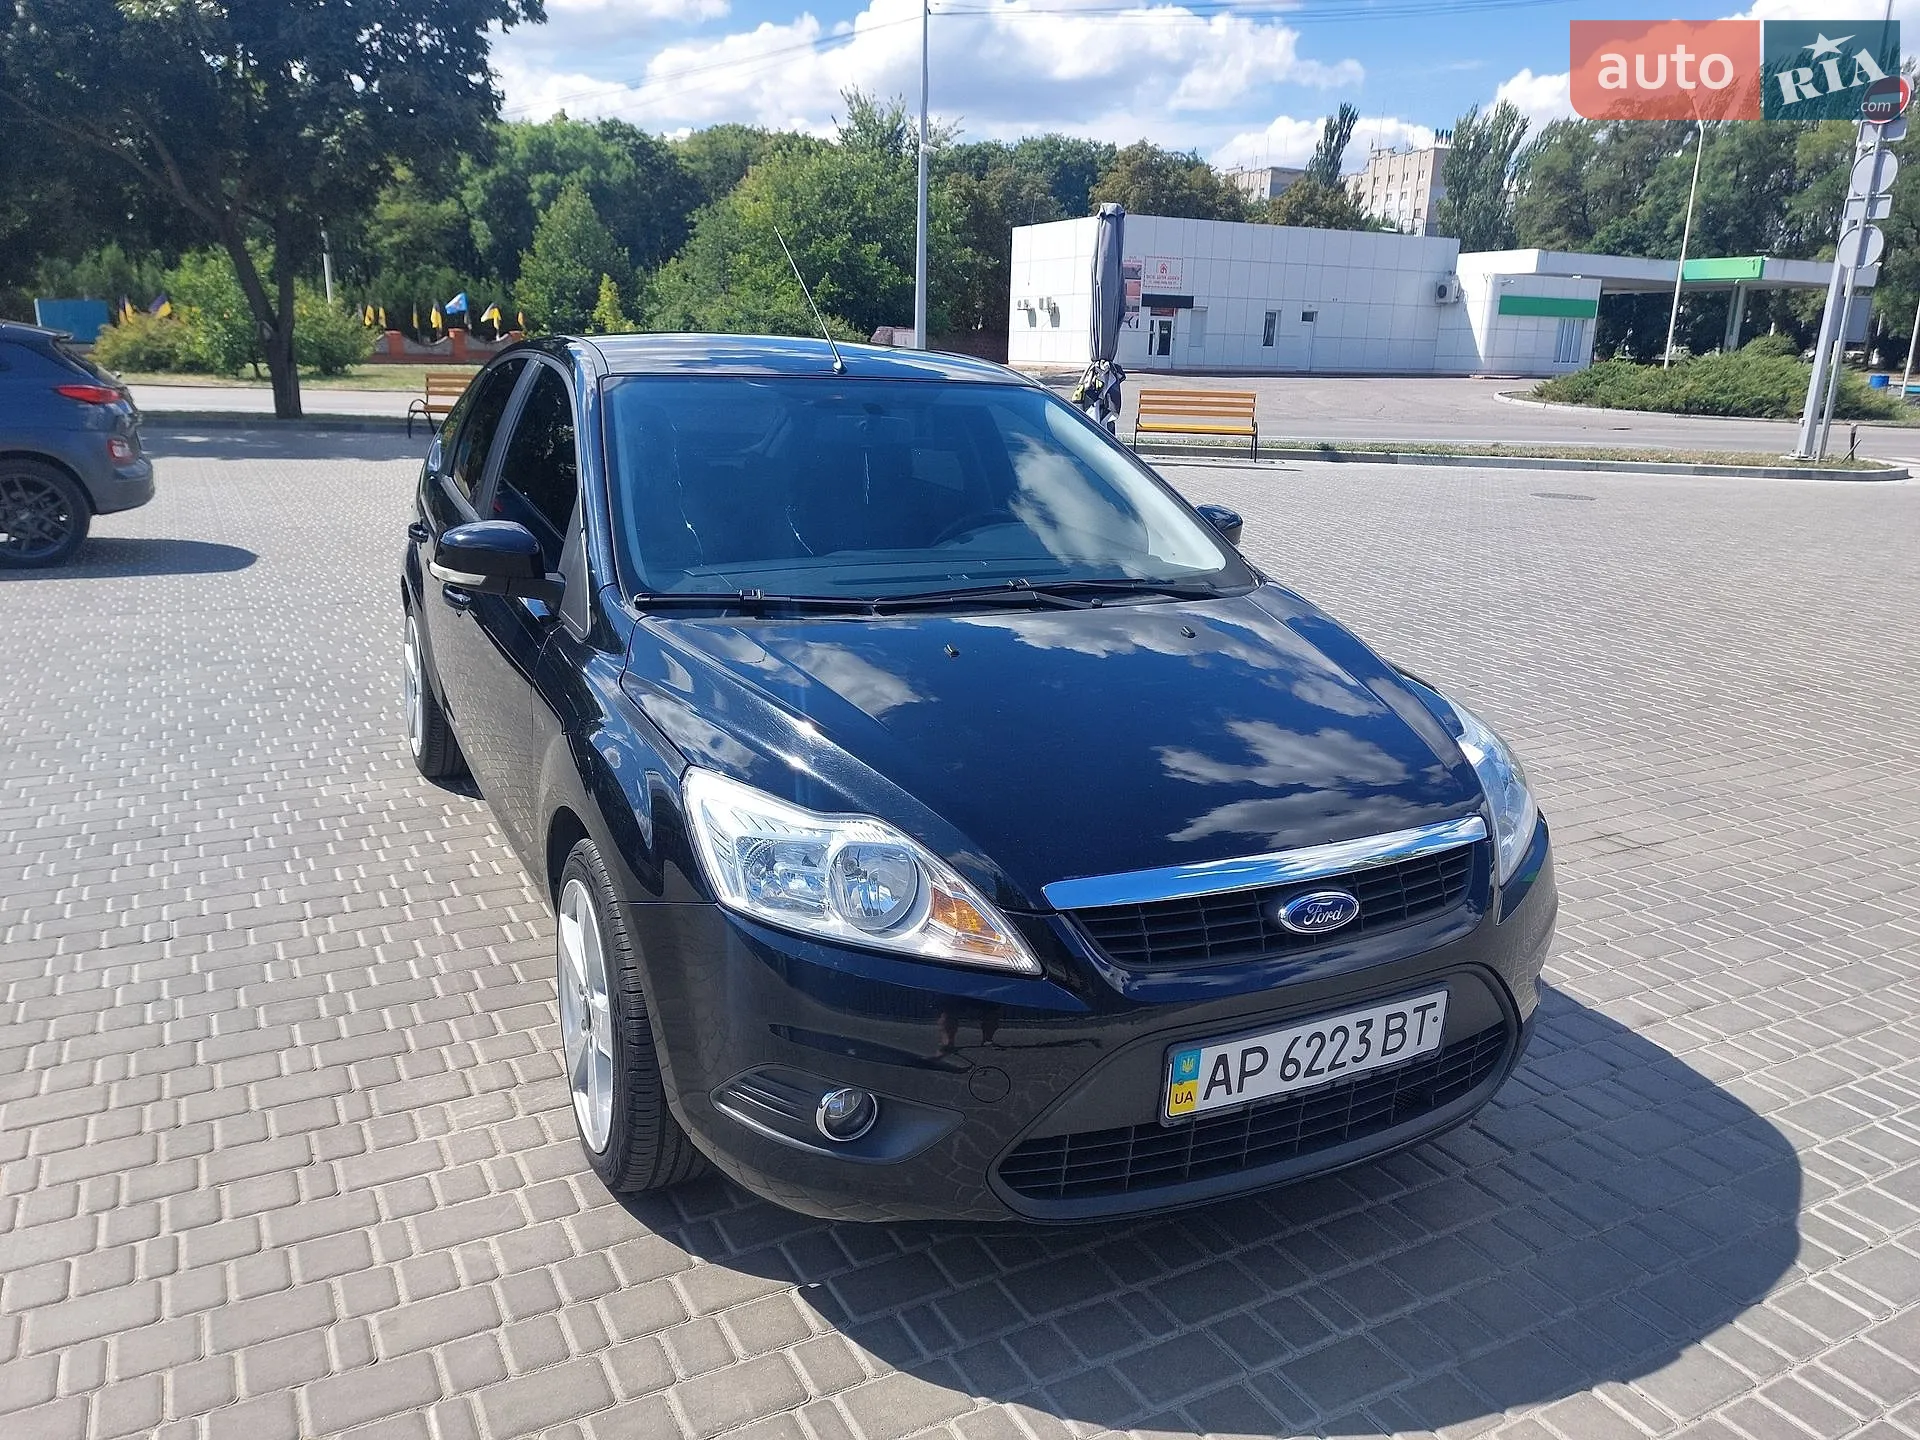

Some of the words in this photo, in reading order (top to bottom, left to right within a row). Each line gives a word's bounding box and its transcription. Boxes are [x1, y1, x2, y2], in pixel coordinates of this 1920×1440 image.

[1303, 900, 1344, 926] Ford
[1203, 1045, 1269, 1101] AP
[1279, 1018, 1374, 1082] 6223
[1381, 1001, 1437, 1057] BT
[1174, 1091, 1194, 1106] UA
